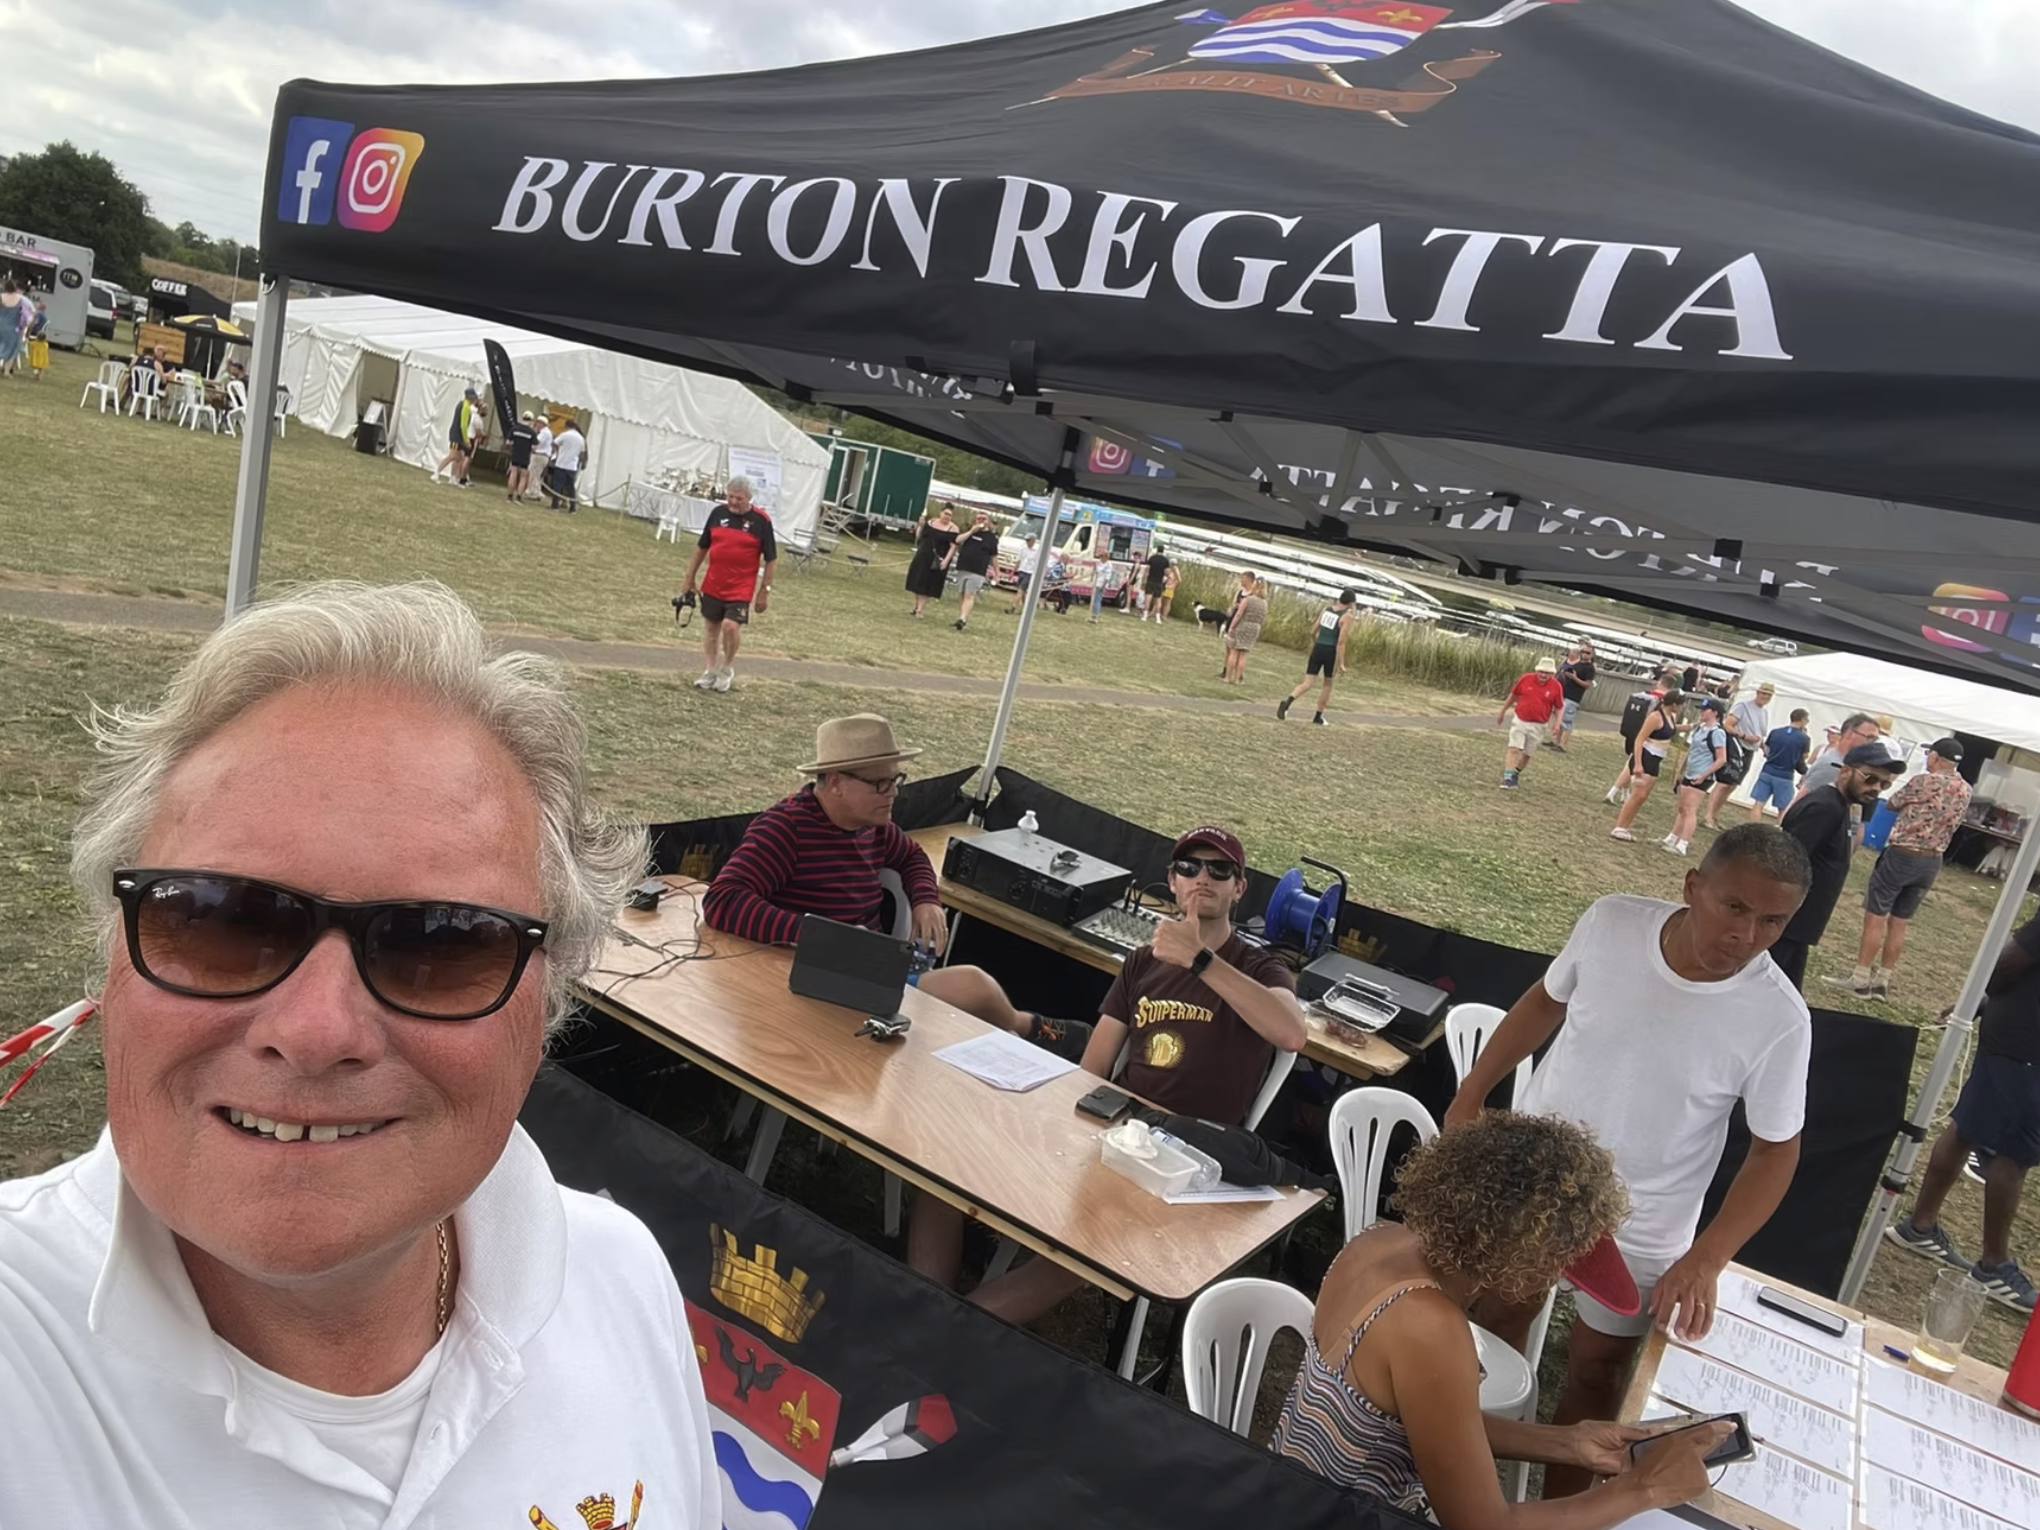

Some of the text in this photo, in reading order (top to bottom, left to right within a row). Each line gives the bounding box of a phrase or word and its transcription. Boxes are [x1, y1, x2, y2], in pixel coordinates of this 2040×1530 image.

[6, 232, 37, 249] BAR
[492, 156, 1794, 361] BURTON REGATTA
[152, 278, 187, 296] COFFEE
